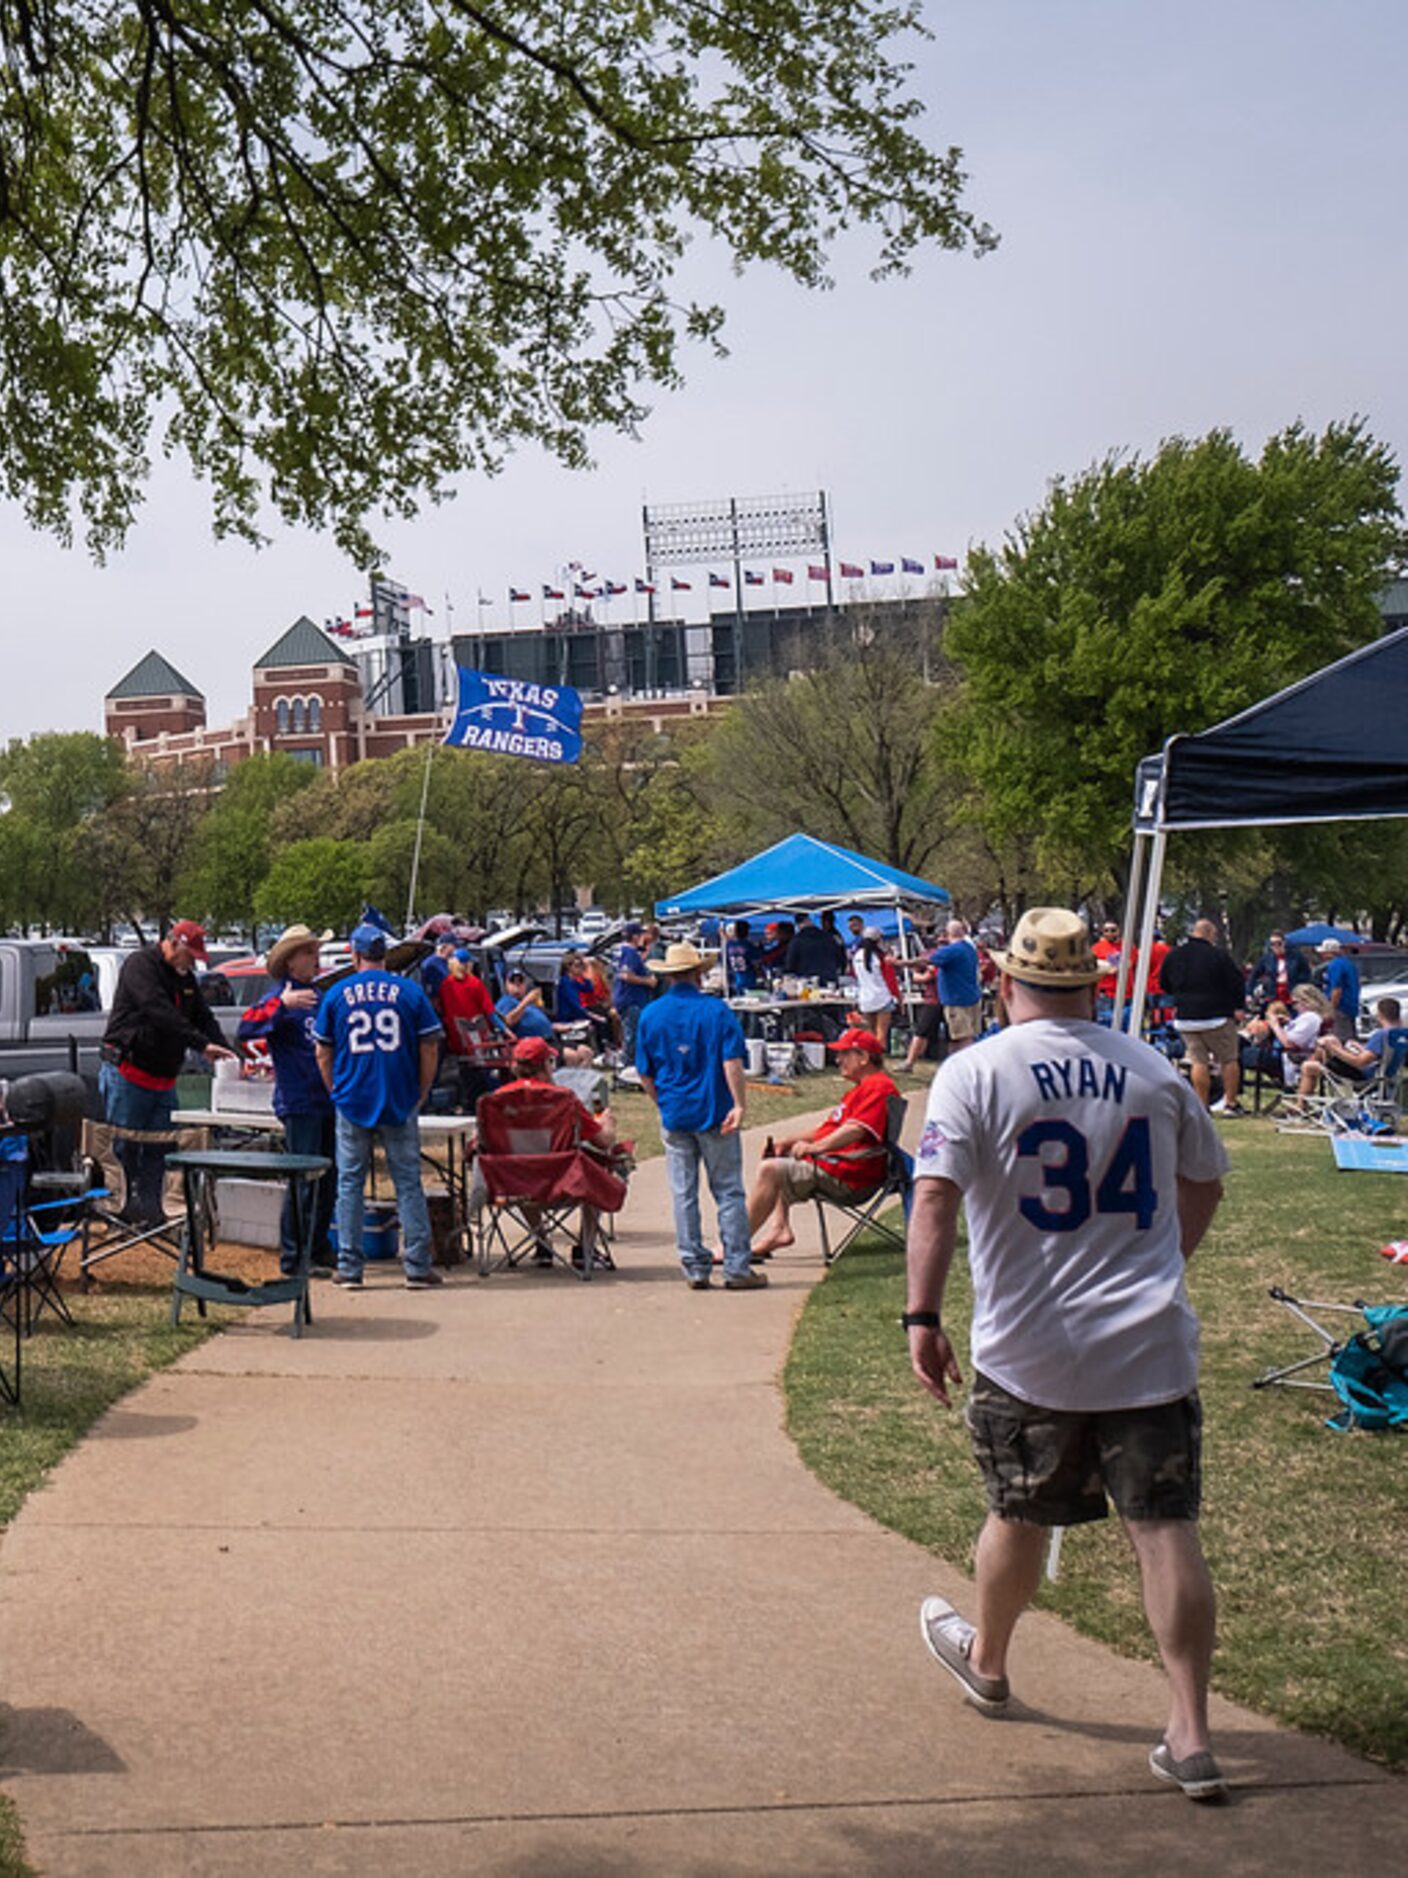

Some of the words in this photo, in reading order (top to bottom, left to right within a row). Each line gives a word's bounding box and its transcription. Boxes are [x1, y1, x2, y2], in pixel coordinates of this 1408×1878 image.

[461, 725, 563, 759] RANGERS
[343, 981, 400, 1005] GREER
[348, 1008, 400, 1053] 29
[1030, 1058, 1127, 1103] RYAN
[1017, 1116, 1158, 1232] 34
